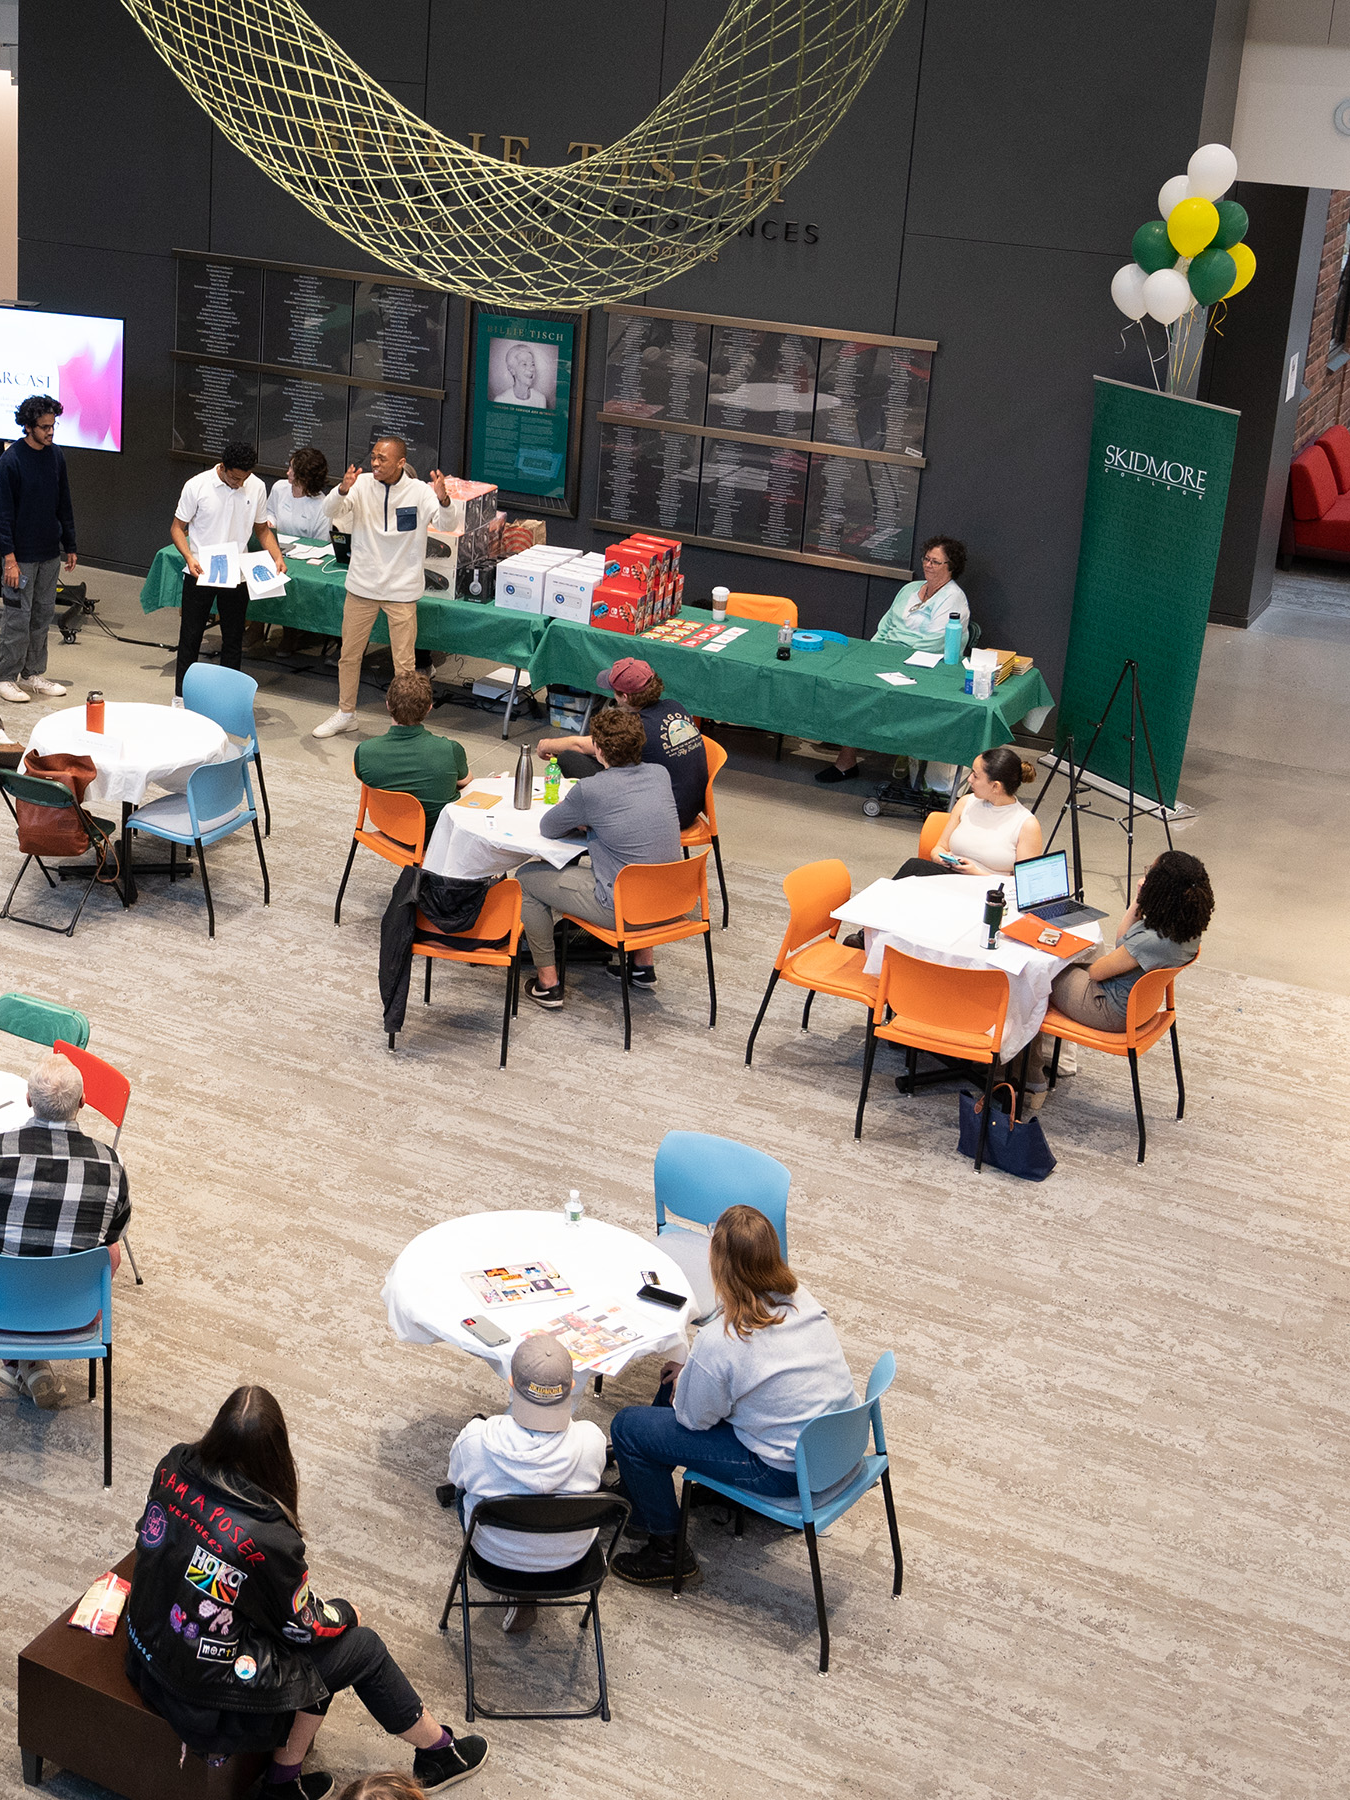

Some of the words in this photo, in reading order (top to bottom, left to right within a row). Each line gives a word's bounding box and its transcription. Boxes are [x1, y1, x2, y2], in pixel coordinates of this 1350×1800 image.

[567, 141, 788, 204] TISCH
[663, 210, 821, 246] SCIENCES
[650, 244, 721, 263] DONORS
[487, 325, 524, 337] BILLIE
[530, 330, 564, 341] TISCH
[1104, 444, 1208, 491] SKIDMORE
[1104, 467, 1203, 500] COLLEGE
[160, 1468, 167, 1485] I
[165, 1473, 189, 1500] AM
[190, 1494, 206, 1511] A
[209, 1507, 266, 1567] POSER
